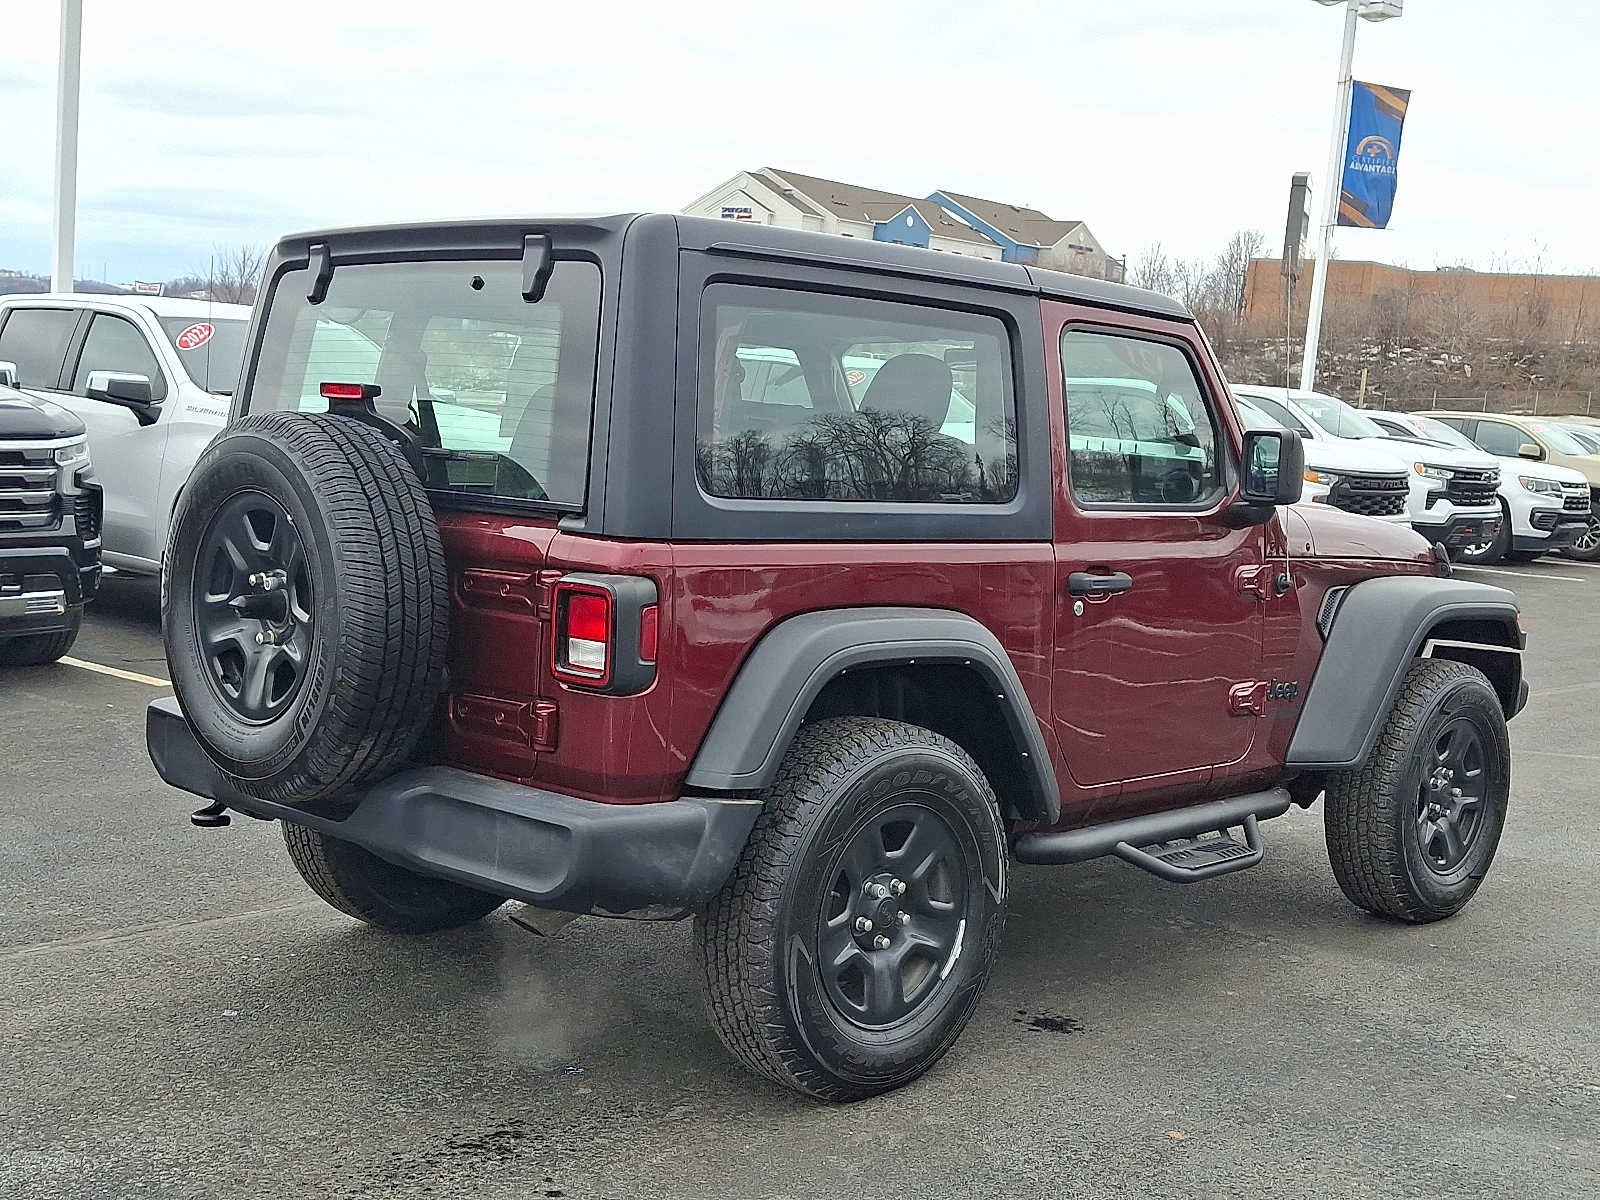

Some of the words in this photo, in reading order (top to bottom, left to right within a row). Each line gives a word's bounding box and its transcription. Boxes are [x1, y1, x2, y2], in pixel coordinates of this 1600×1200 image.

[182, 325, 210, 347] 2022
[186, 405, 228, 418] SILVERAD
[1352, 479, 1409, 488] CHEVROLE
[1267, 677, 1298, 702] Jeep
